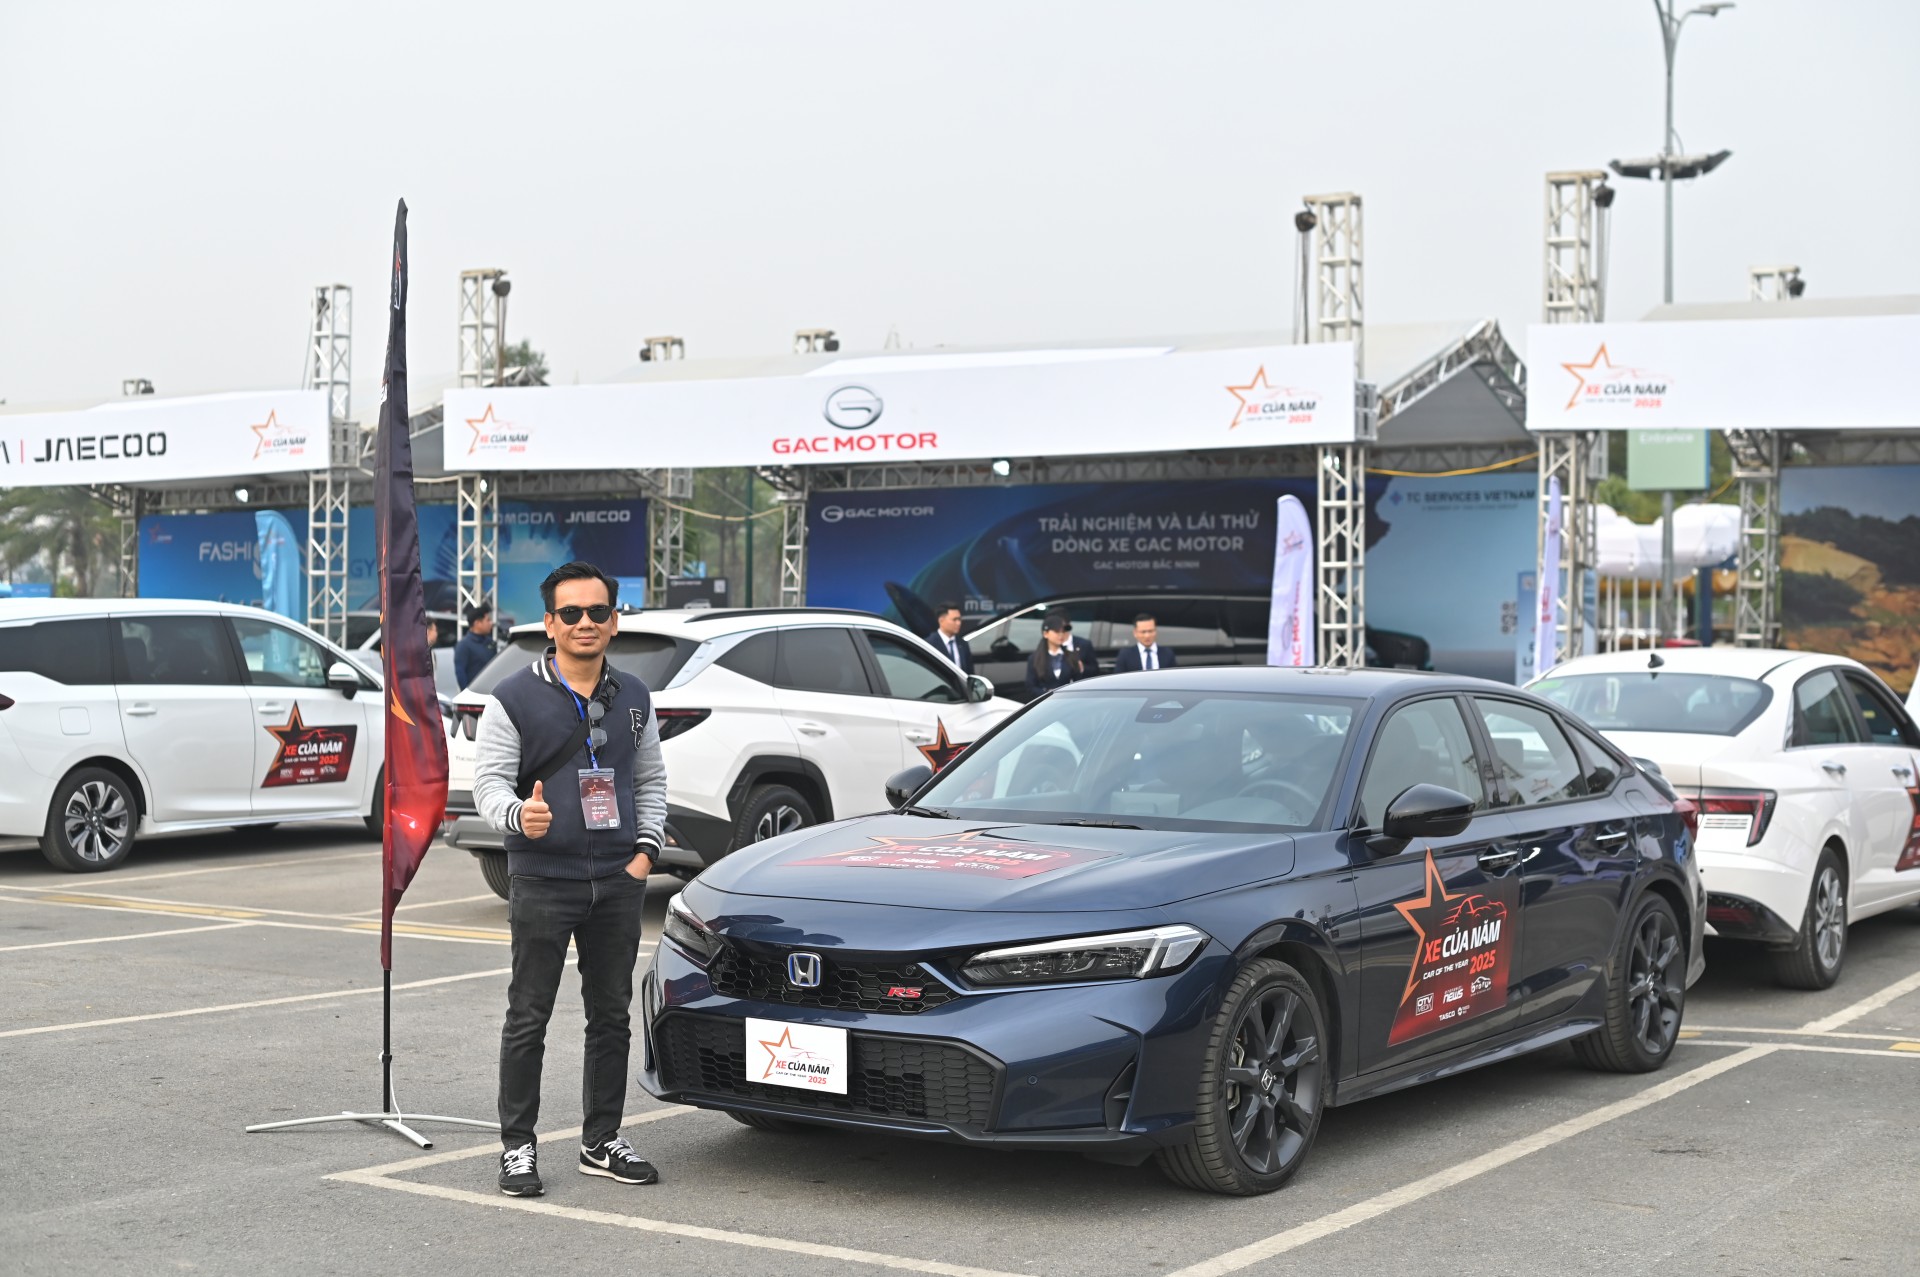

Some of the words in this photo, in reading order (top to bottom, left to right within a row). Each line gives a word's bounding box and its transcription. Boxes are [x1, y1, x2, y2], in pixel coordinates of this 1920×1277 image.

[33, 431, 167, 462] JAECOO
[772, 437, 828, 454] GAC
[833, 432, 938, 452] MOTOR
[1407, 492, 1421, 503] TC
[1425, 490, 1481, 503] SERVICES
[1484, 489, 1536, 501] VIETNAM
[565, 510, 631, 524] JAECOO
[845, 508, 876, 519] GAC
[878, 506, 935, 517] MOTOR
[1038, 512, 1077, 532] TRẢI
[1082, 512, 1152, 535] NGHIỆM
[1156, 512, 1182, 531] VÀ
[1187, 511, 1215, 531] LÁI
[1220, 509, 1260, 530] THỬ
[1052, 535, 1104, 554] DÒNG
[1108, 537, 1131, 553] XE
[1135, 537, 1173, 552] GAC
[1178, 535, 1245, 552] MOTOR
[284, 745, 297, 756] XE
[298, 740, 318, 756] CỦA
[319, 740, 343, 754] NĂM
[319, 754, 339, 765] 2025
[918, 845, 979, 854] CỦA
[975, 849, 1052, 861] NĂM
[1423, 938, 1442, 965] XE
[1442, 927, 1469, 958] CỦA
[1470, 920, 1501, 951] NĂM
[1423, 969, 1435, 980] CAR
[1435, 967, 1443, 977] OF
[1444, 963, 1454, 973] THE
[1454, 959, 1469, 970] YEAR
[1469, 950, 1496, 975] 2025
[887, 986, 924, 998] RS
[775, 1060, 787, 1069] XE
[788, 1060, 806, 1072] CỦA
[807, 1063, 830, 1075] NĂM
[808, 1075, 827, 1085] 2025
